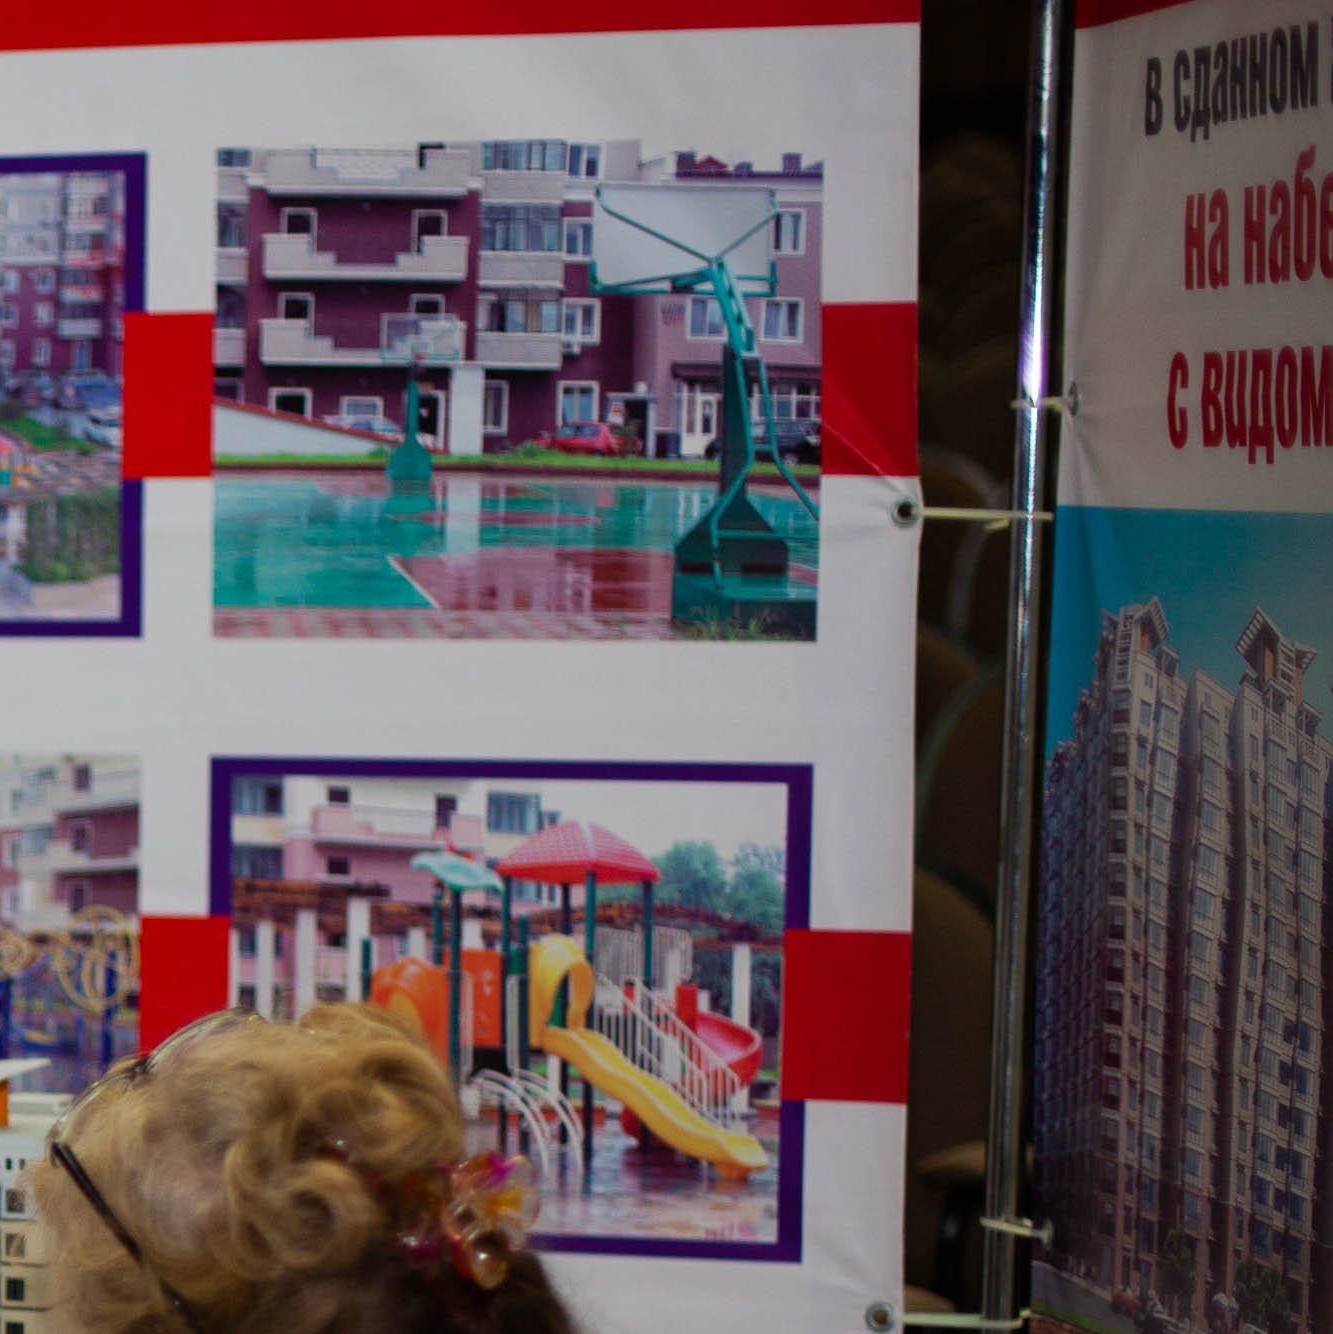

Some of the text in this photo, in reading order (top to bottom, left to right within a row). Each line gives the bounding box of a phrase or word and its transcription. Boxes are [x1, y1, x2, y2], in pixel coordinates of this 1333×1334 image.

[1173, 20, 1319, 142] сданном
[1184, 187, 1230, 291] на
[1200, 345, 1333, 465] видом
